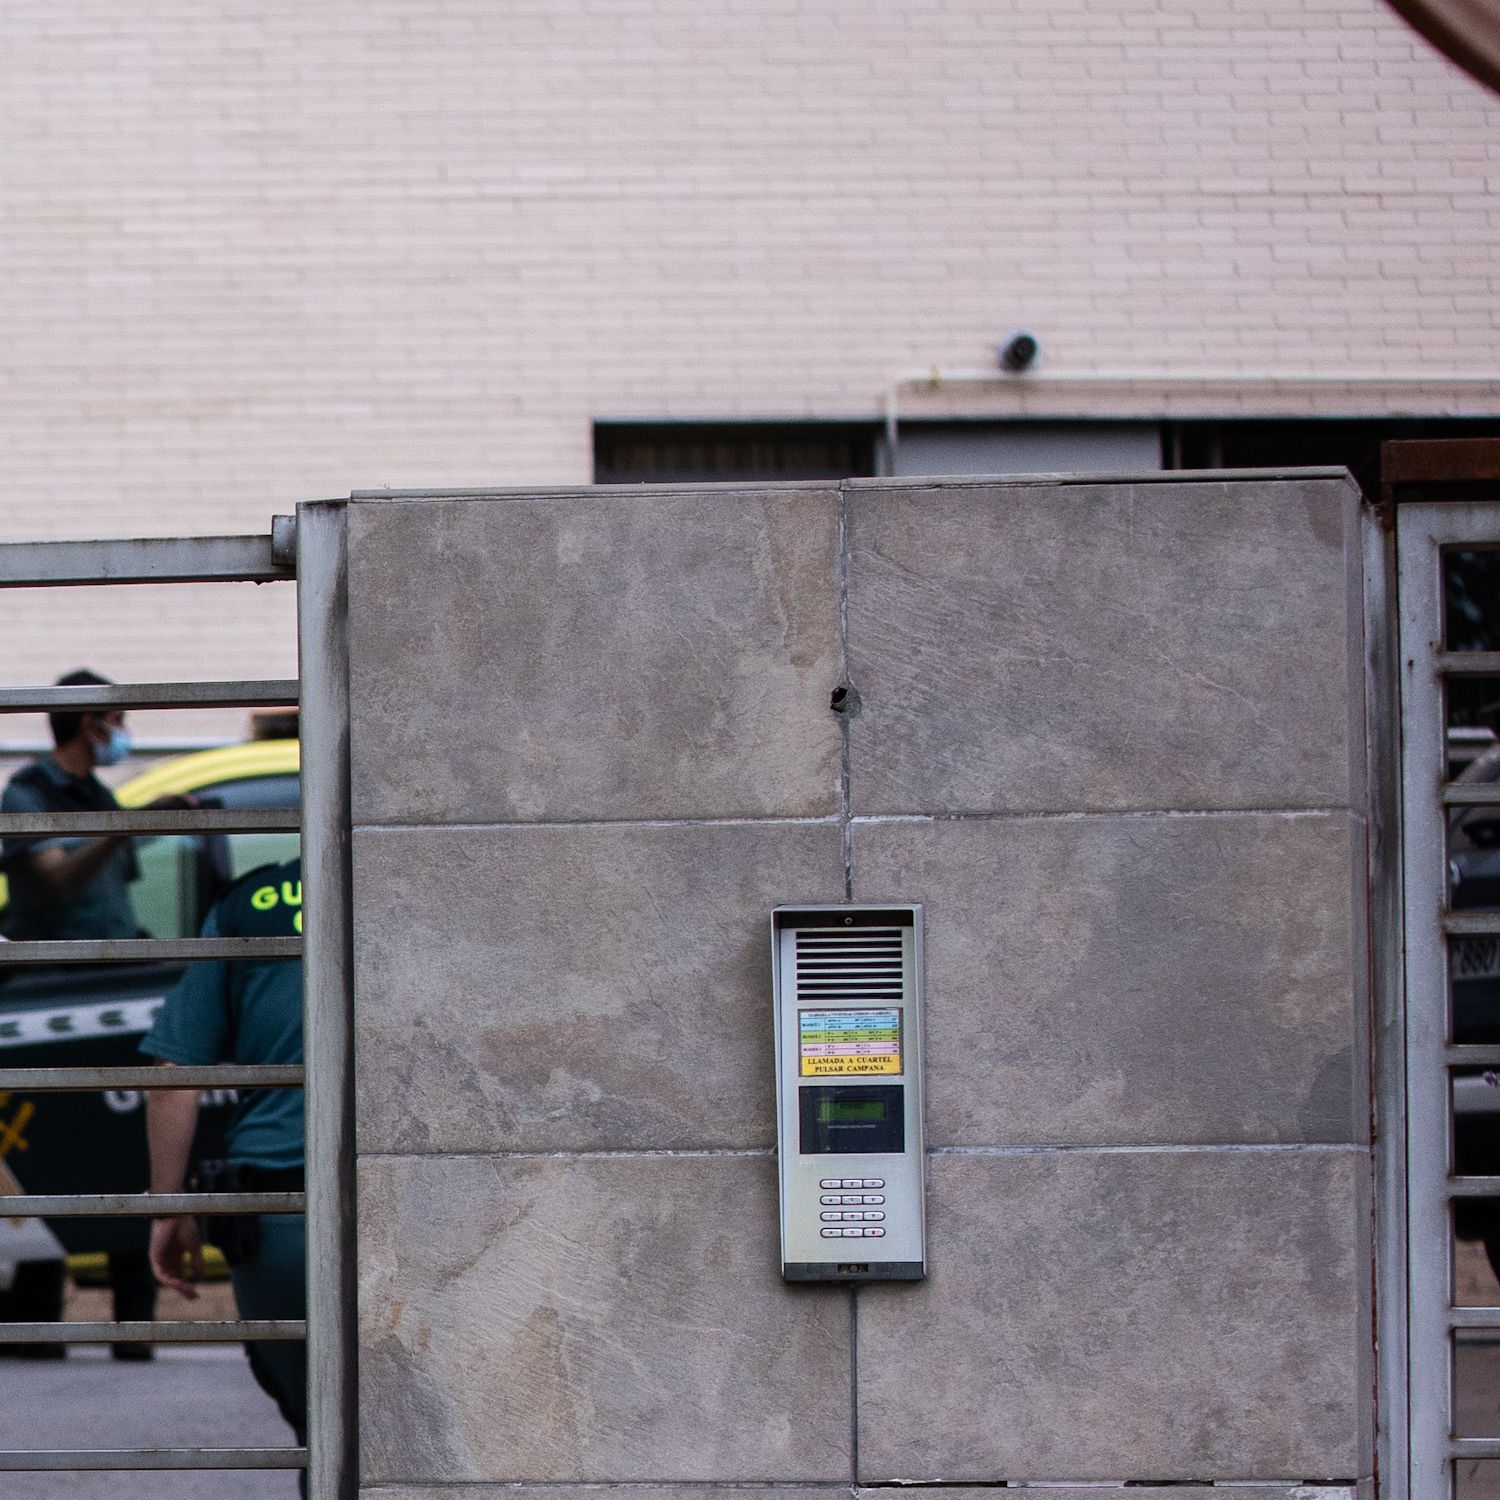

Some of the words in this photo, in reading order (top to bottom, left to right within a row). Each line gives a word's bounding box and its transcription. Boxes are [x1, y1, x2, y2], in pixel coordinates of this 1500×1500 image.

[807, 1057, 845, 1065] LLAMADA
[814, 1065, 843, 1073] PULSAR
[846, 1064, 885, 1072] CAMPANA
